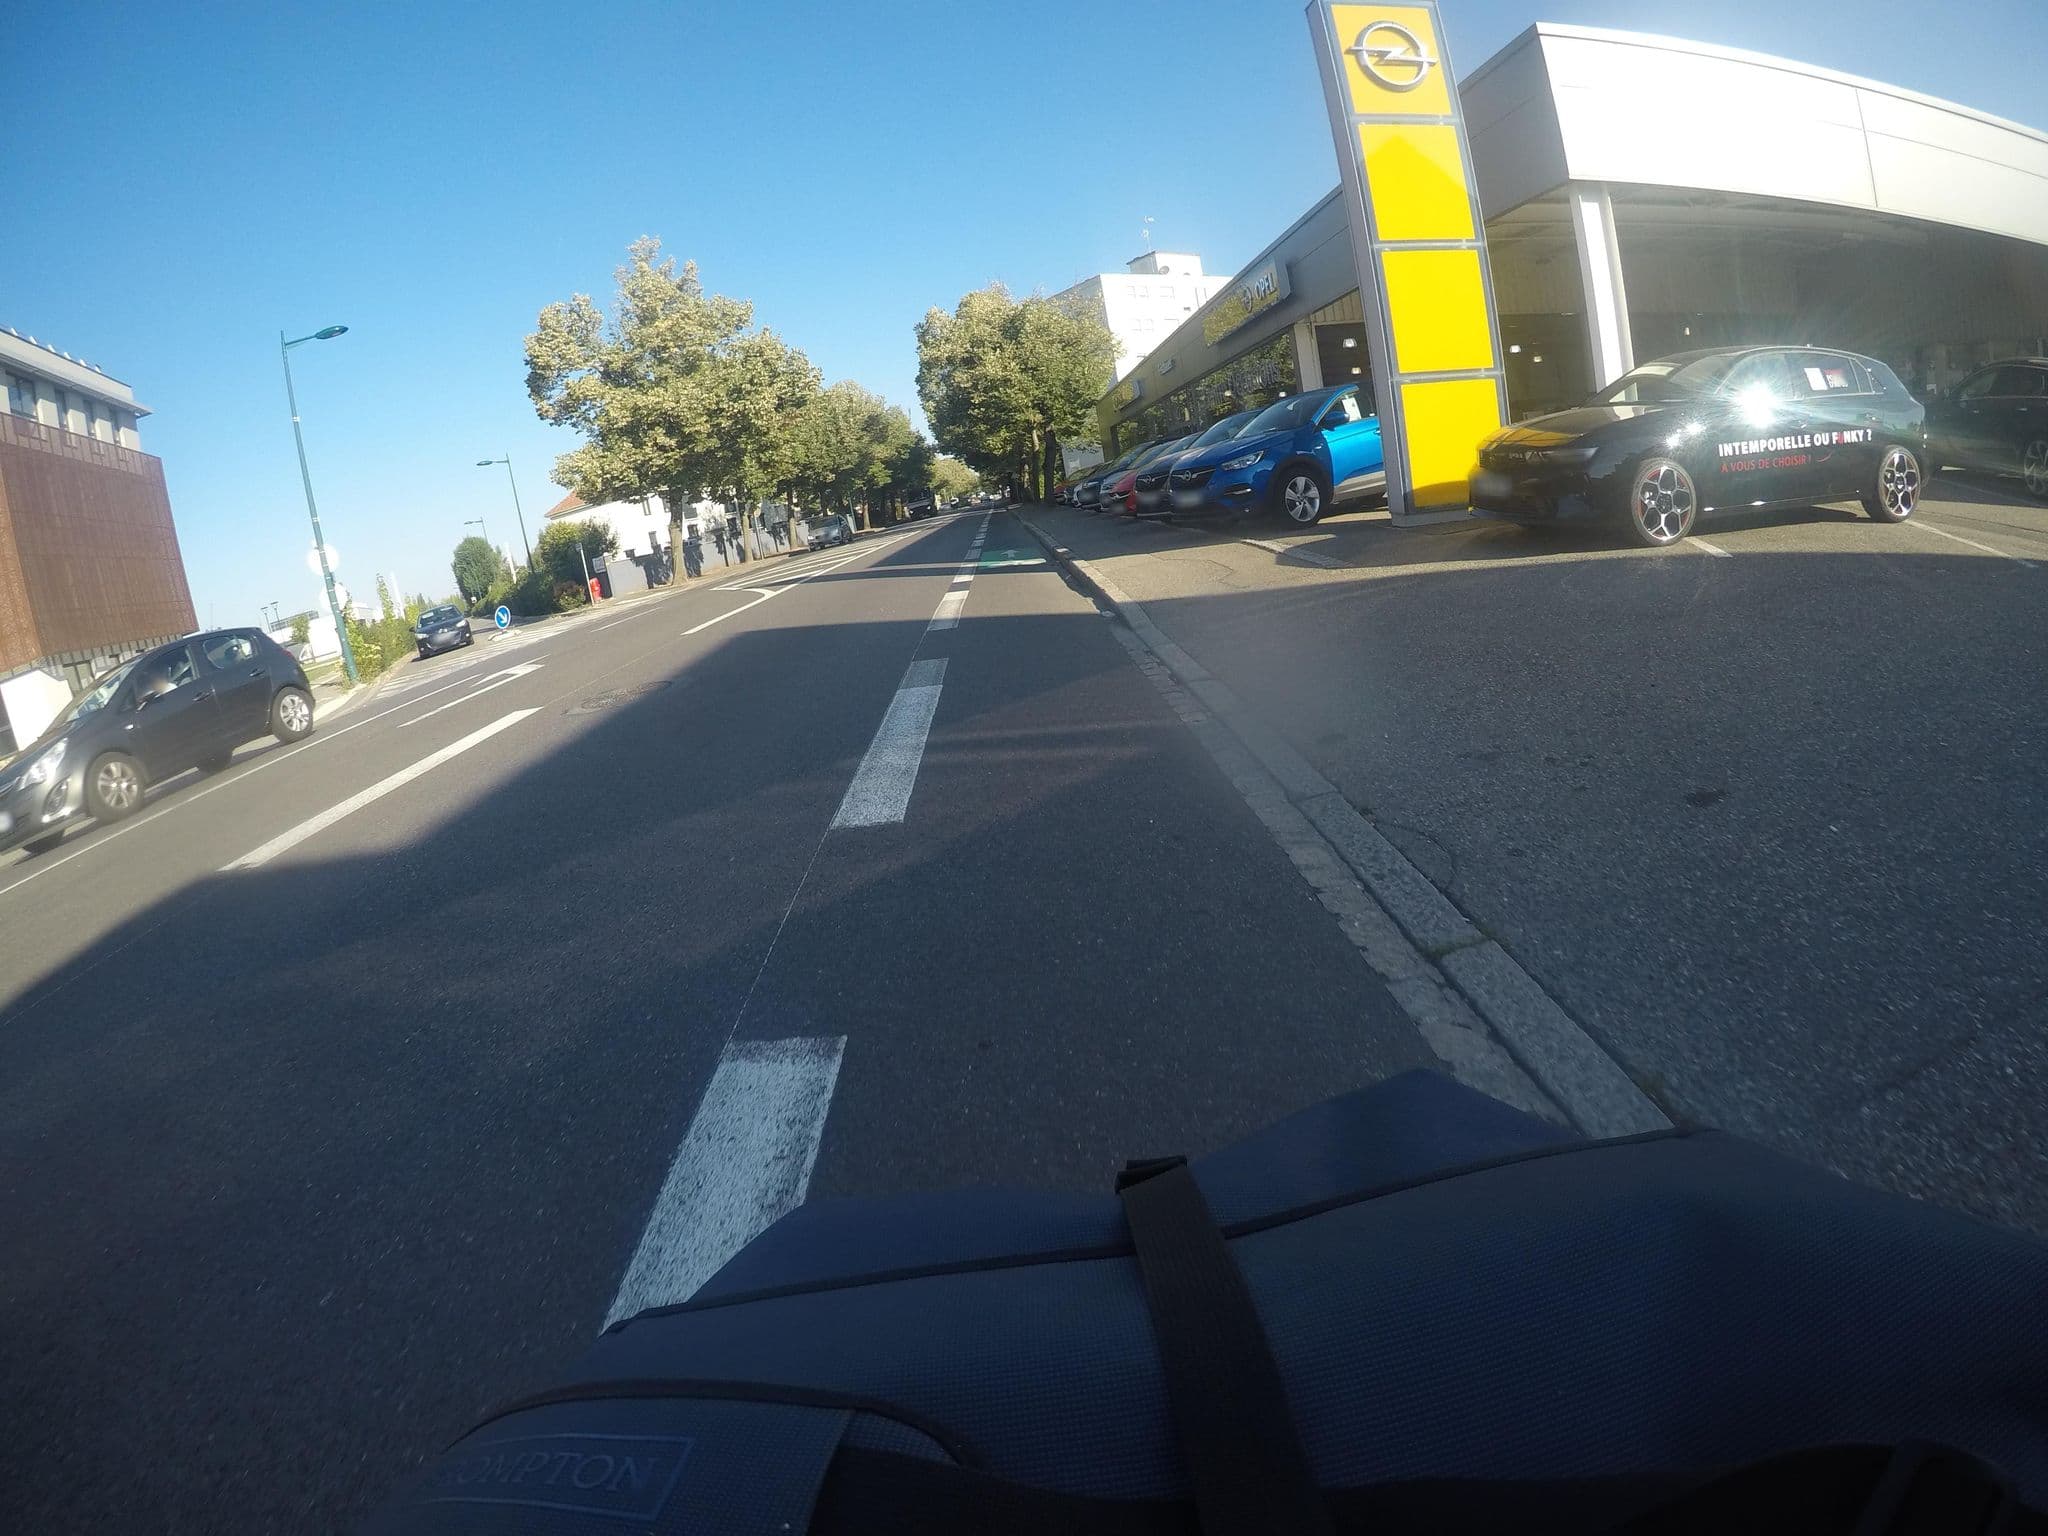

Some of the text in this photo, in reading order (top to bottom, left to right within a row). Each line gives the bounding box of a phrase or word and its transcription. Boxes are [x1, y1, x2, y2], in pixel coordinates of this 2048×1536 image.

[1254, 272, 1277, 299] OPEL
[1718, 437, 1811, 457] INTEMPORELLE
[1814, 433, 1829, 446] OU
[1731, 460, 1755, 472] VOUS
[1759, 459, 1770, 469] DE
[438, 1453, 657, 1491] OMPTON
